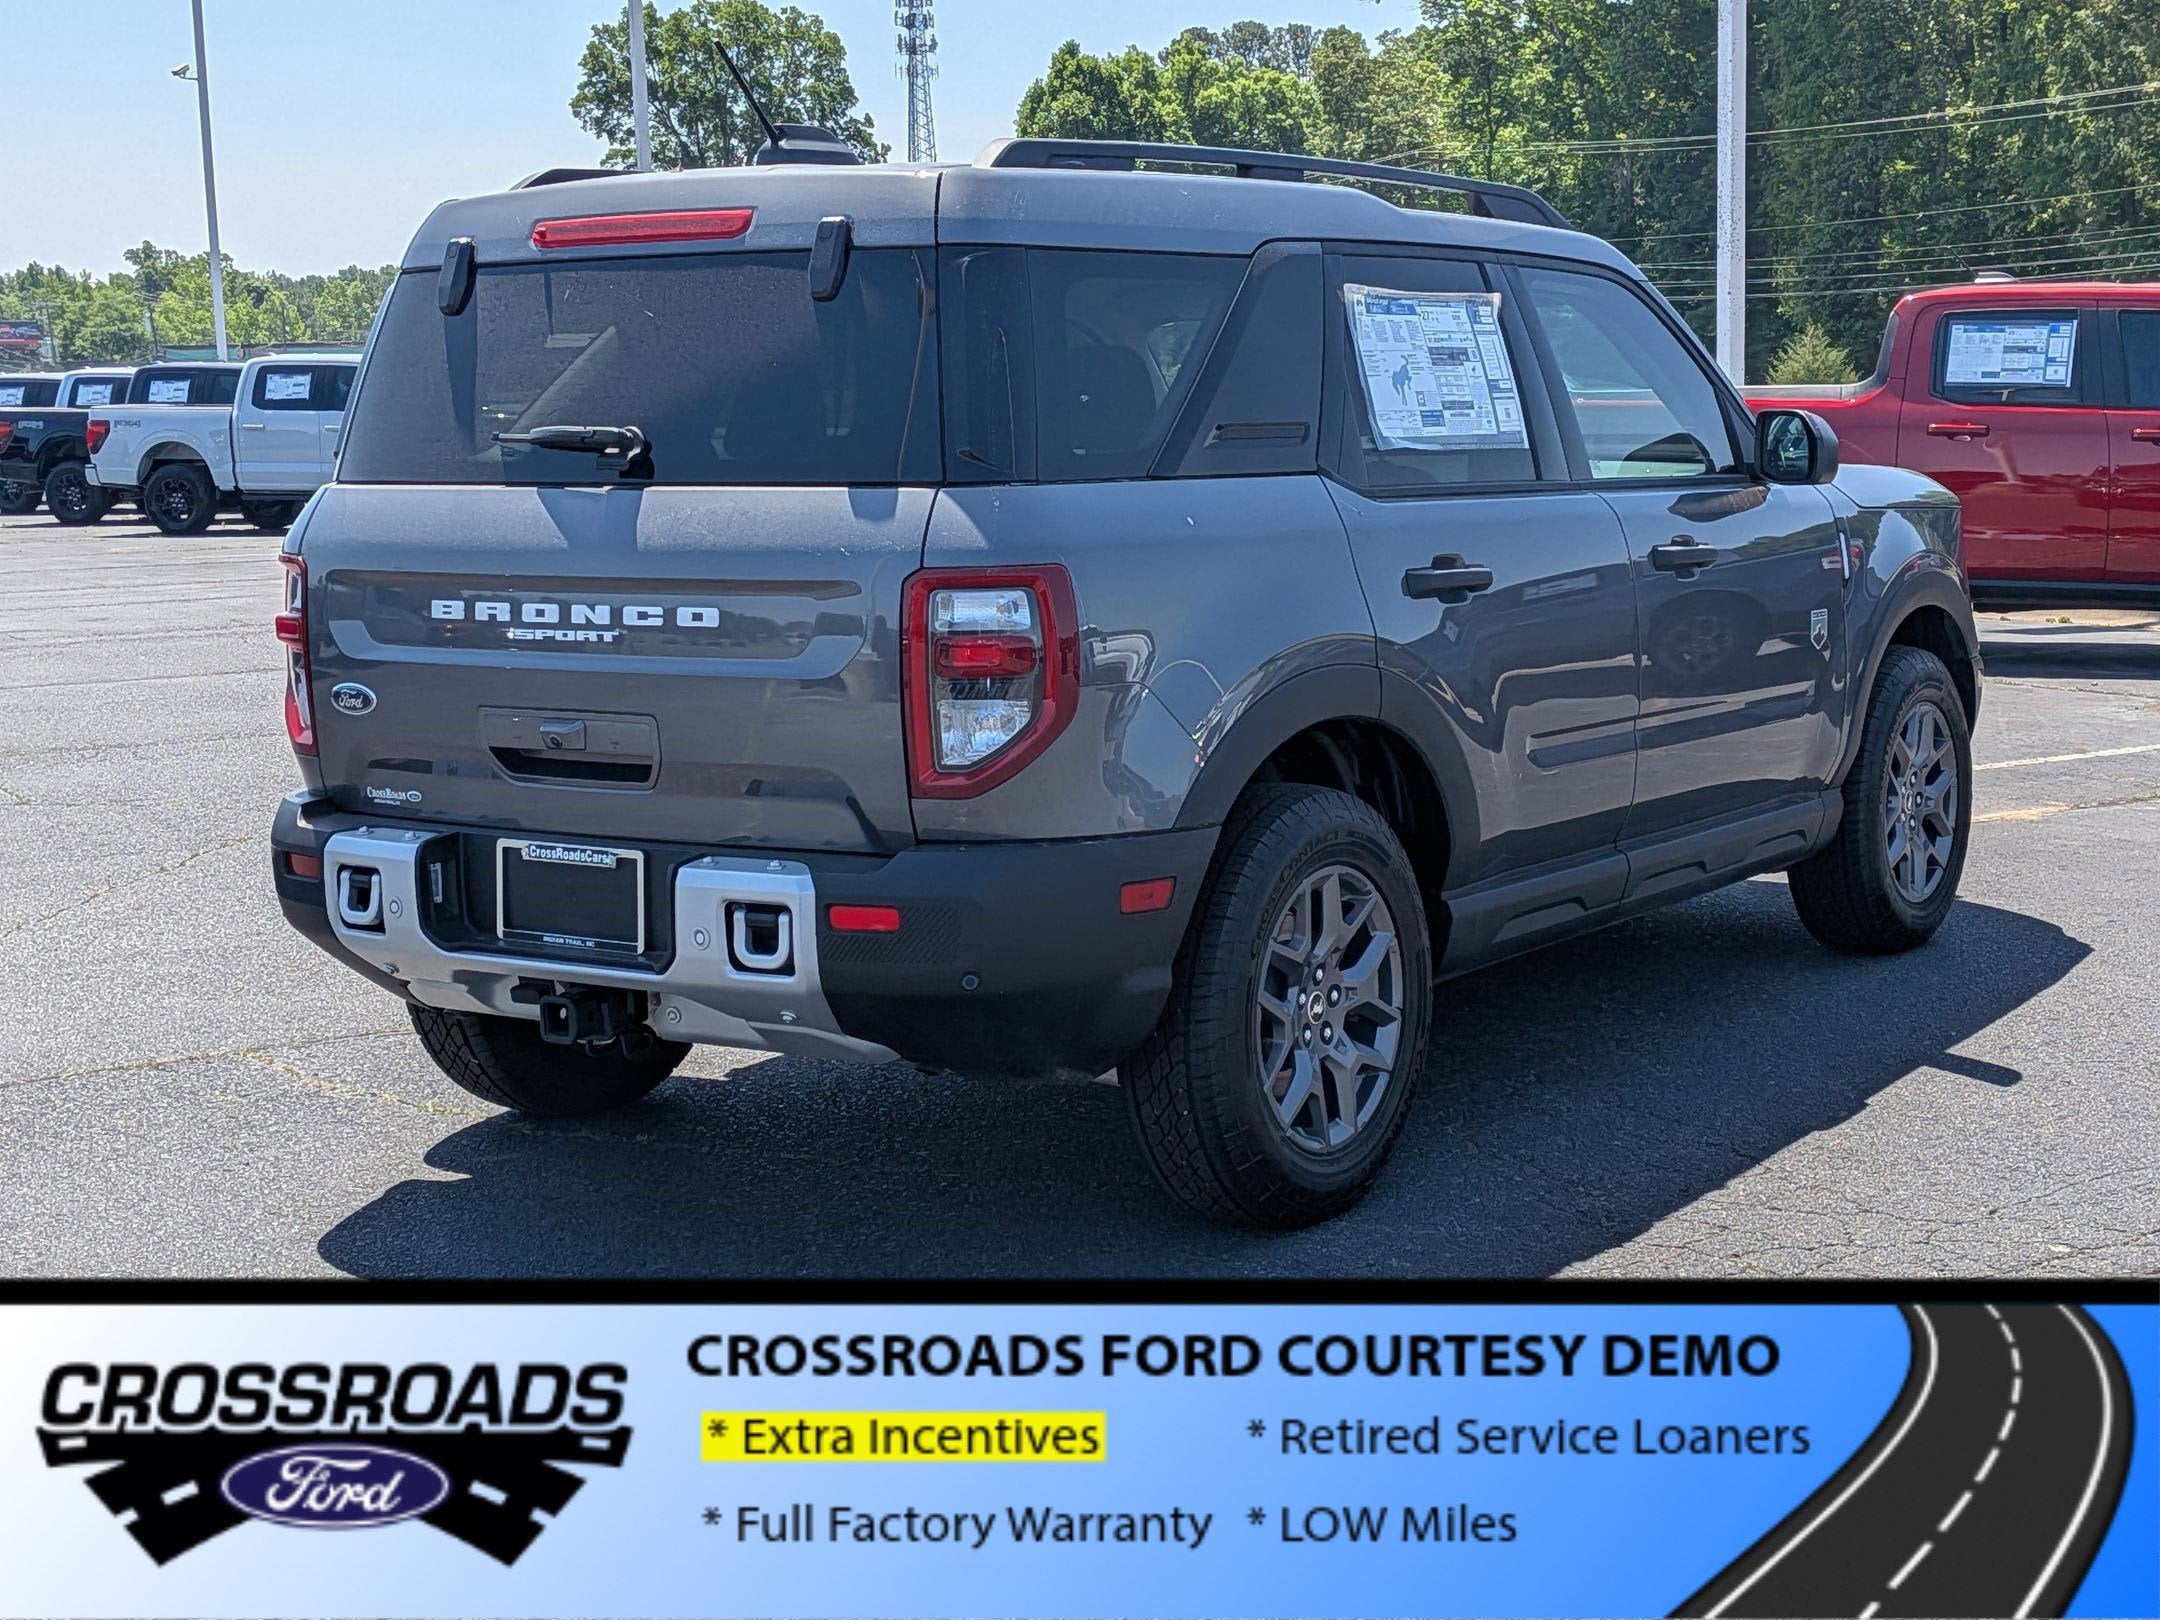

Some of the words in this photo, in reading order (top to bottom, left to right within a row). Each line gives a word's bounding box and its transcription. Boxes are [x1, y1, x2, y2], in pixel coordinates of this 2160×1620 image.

[431, 600, 720, 628] BRONCO
[513, 629, 619, 643] SPORT
[338, 688, 364, 708] Ford
